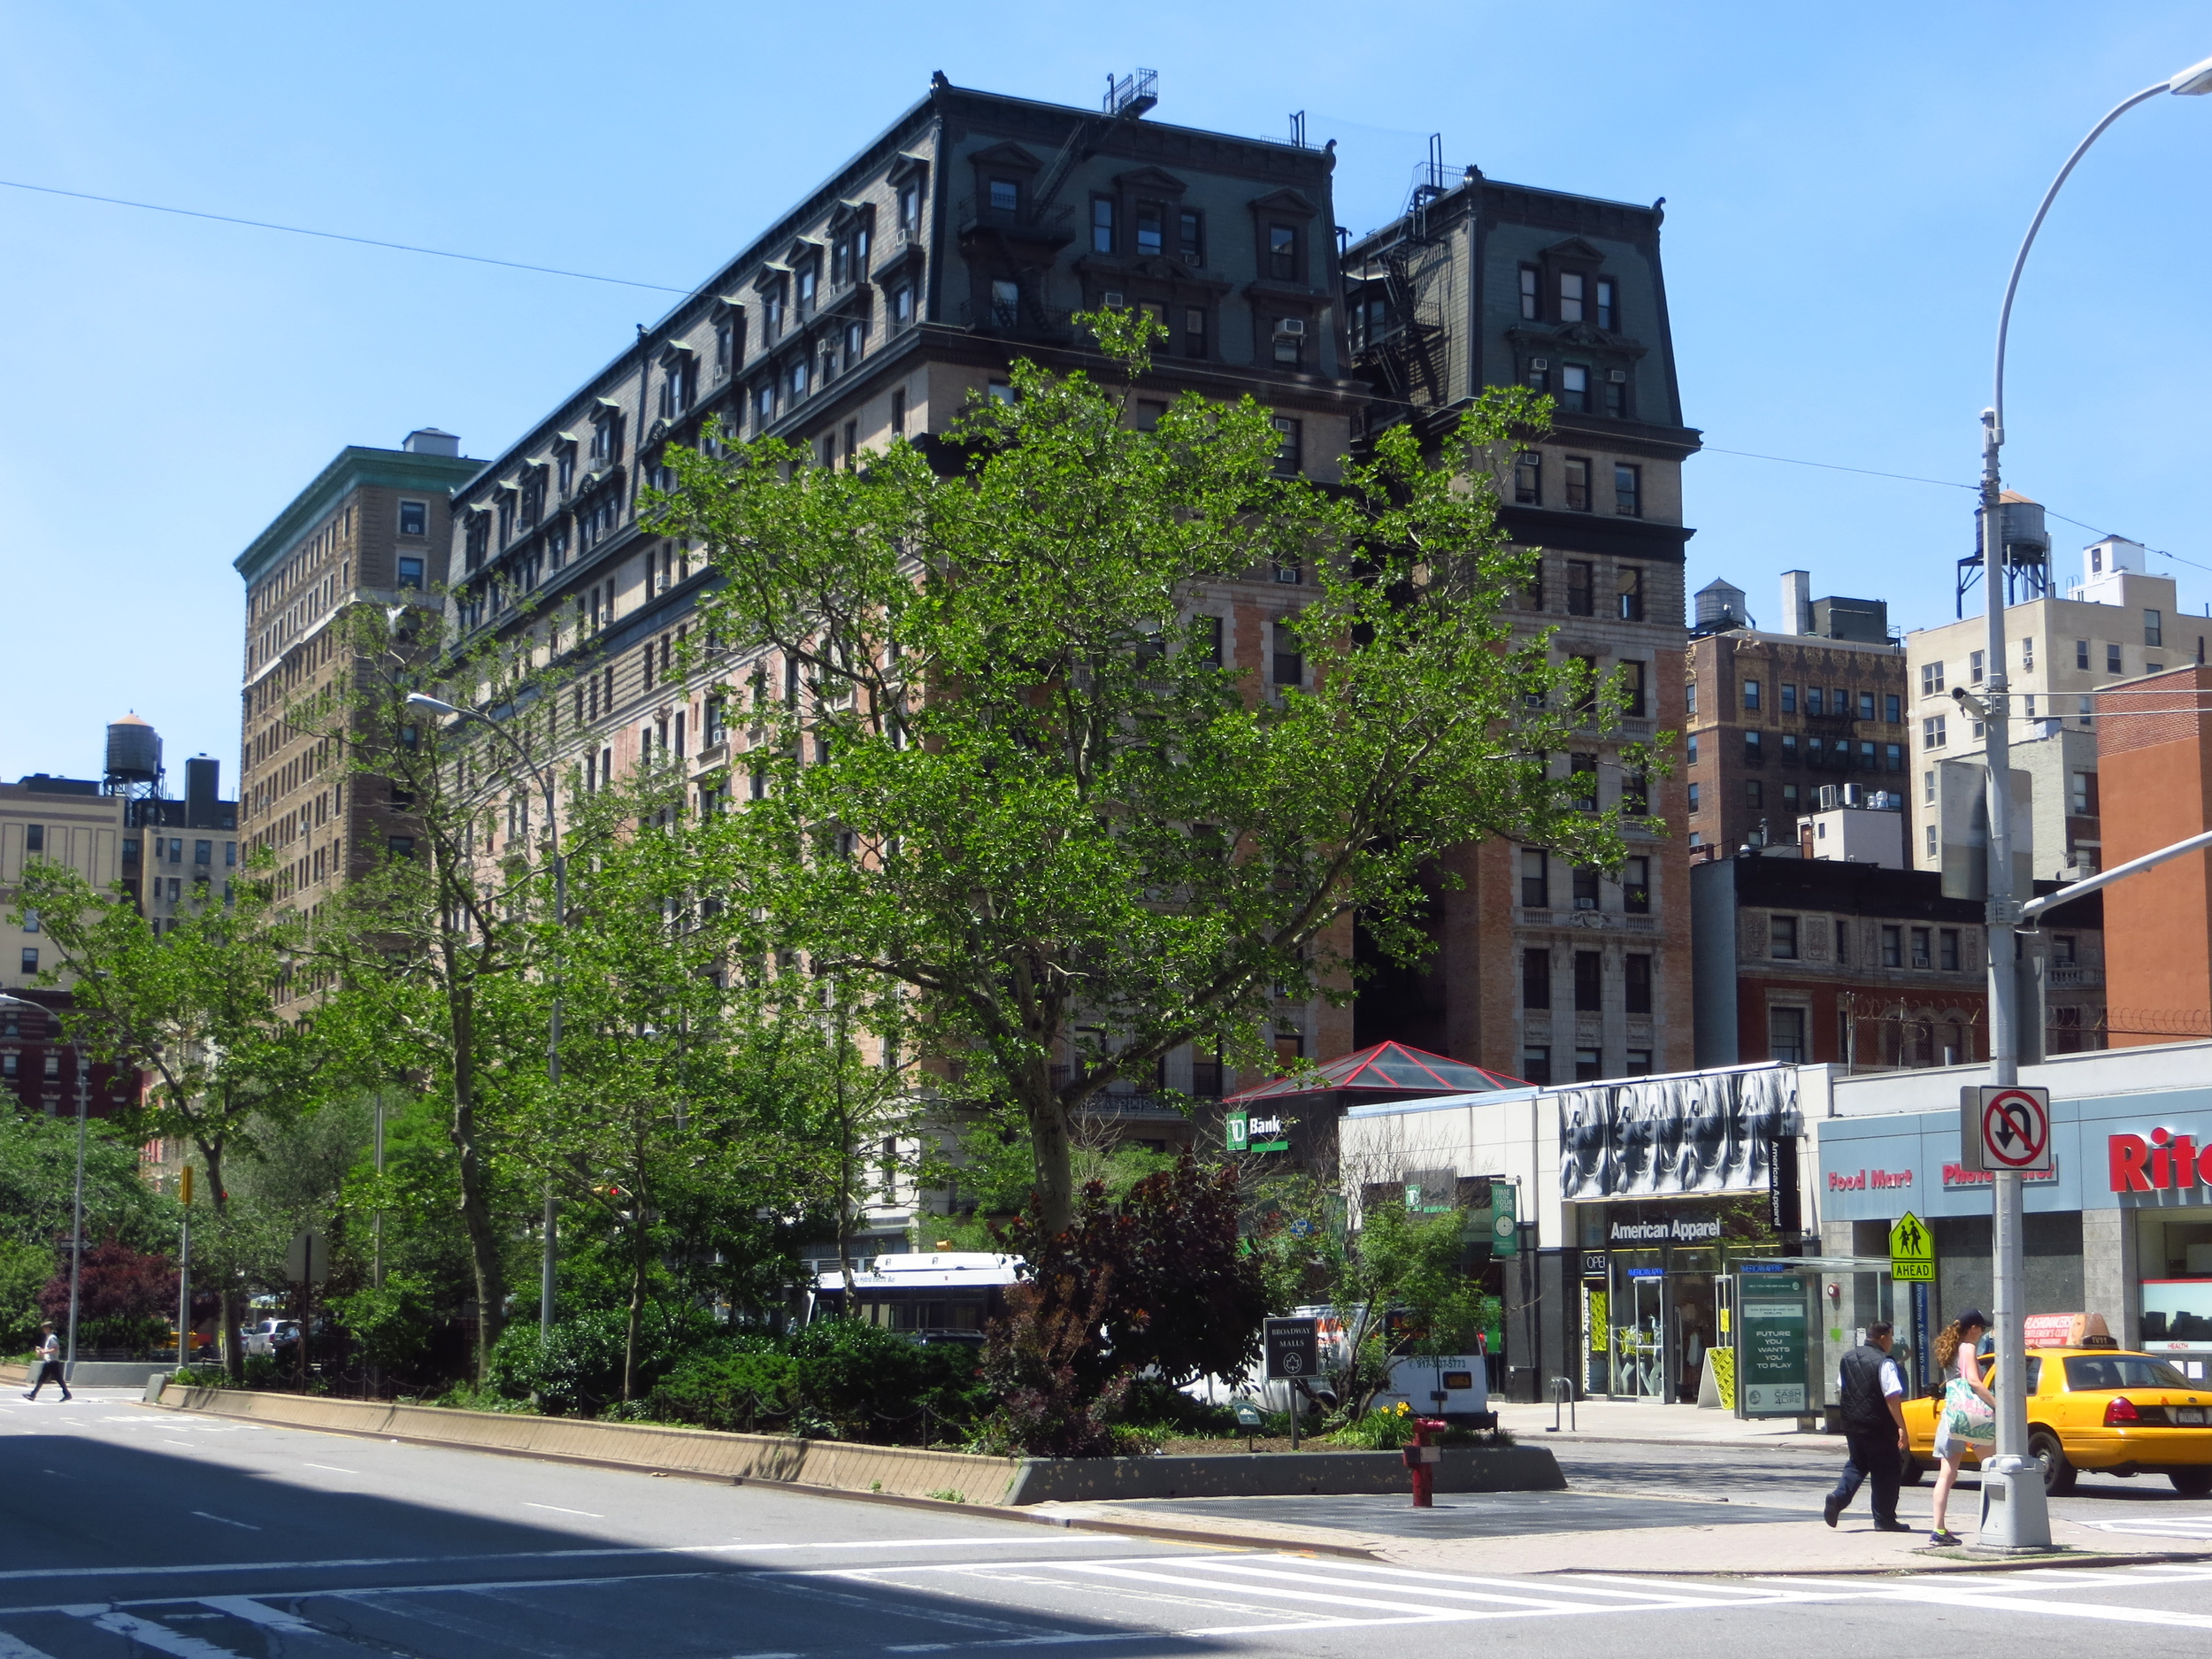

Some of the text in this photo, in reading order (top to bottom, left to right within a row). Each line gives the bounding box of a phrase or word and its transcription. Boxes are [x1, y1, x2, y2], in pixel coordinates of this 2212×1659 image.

[1249, 1115, 1281, 1134] Bank
[1828, 1169, 1913, 1191] Food Mart
[1772, 1189, 1781, 1227] Apparel
[1610, 1218, 1720, 1240] American Apparel
[1896, 1263, 1929, 1276] AHEAD
